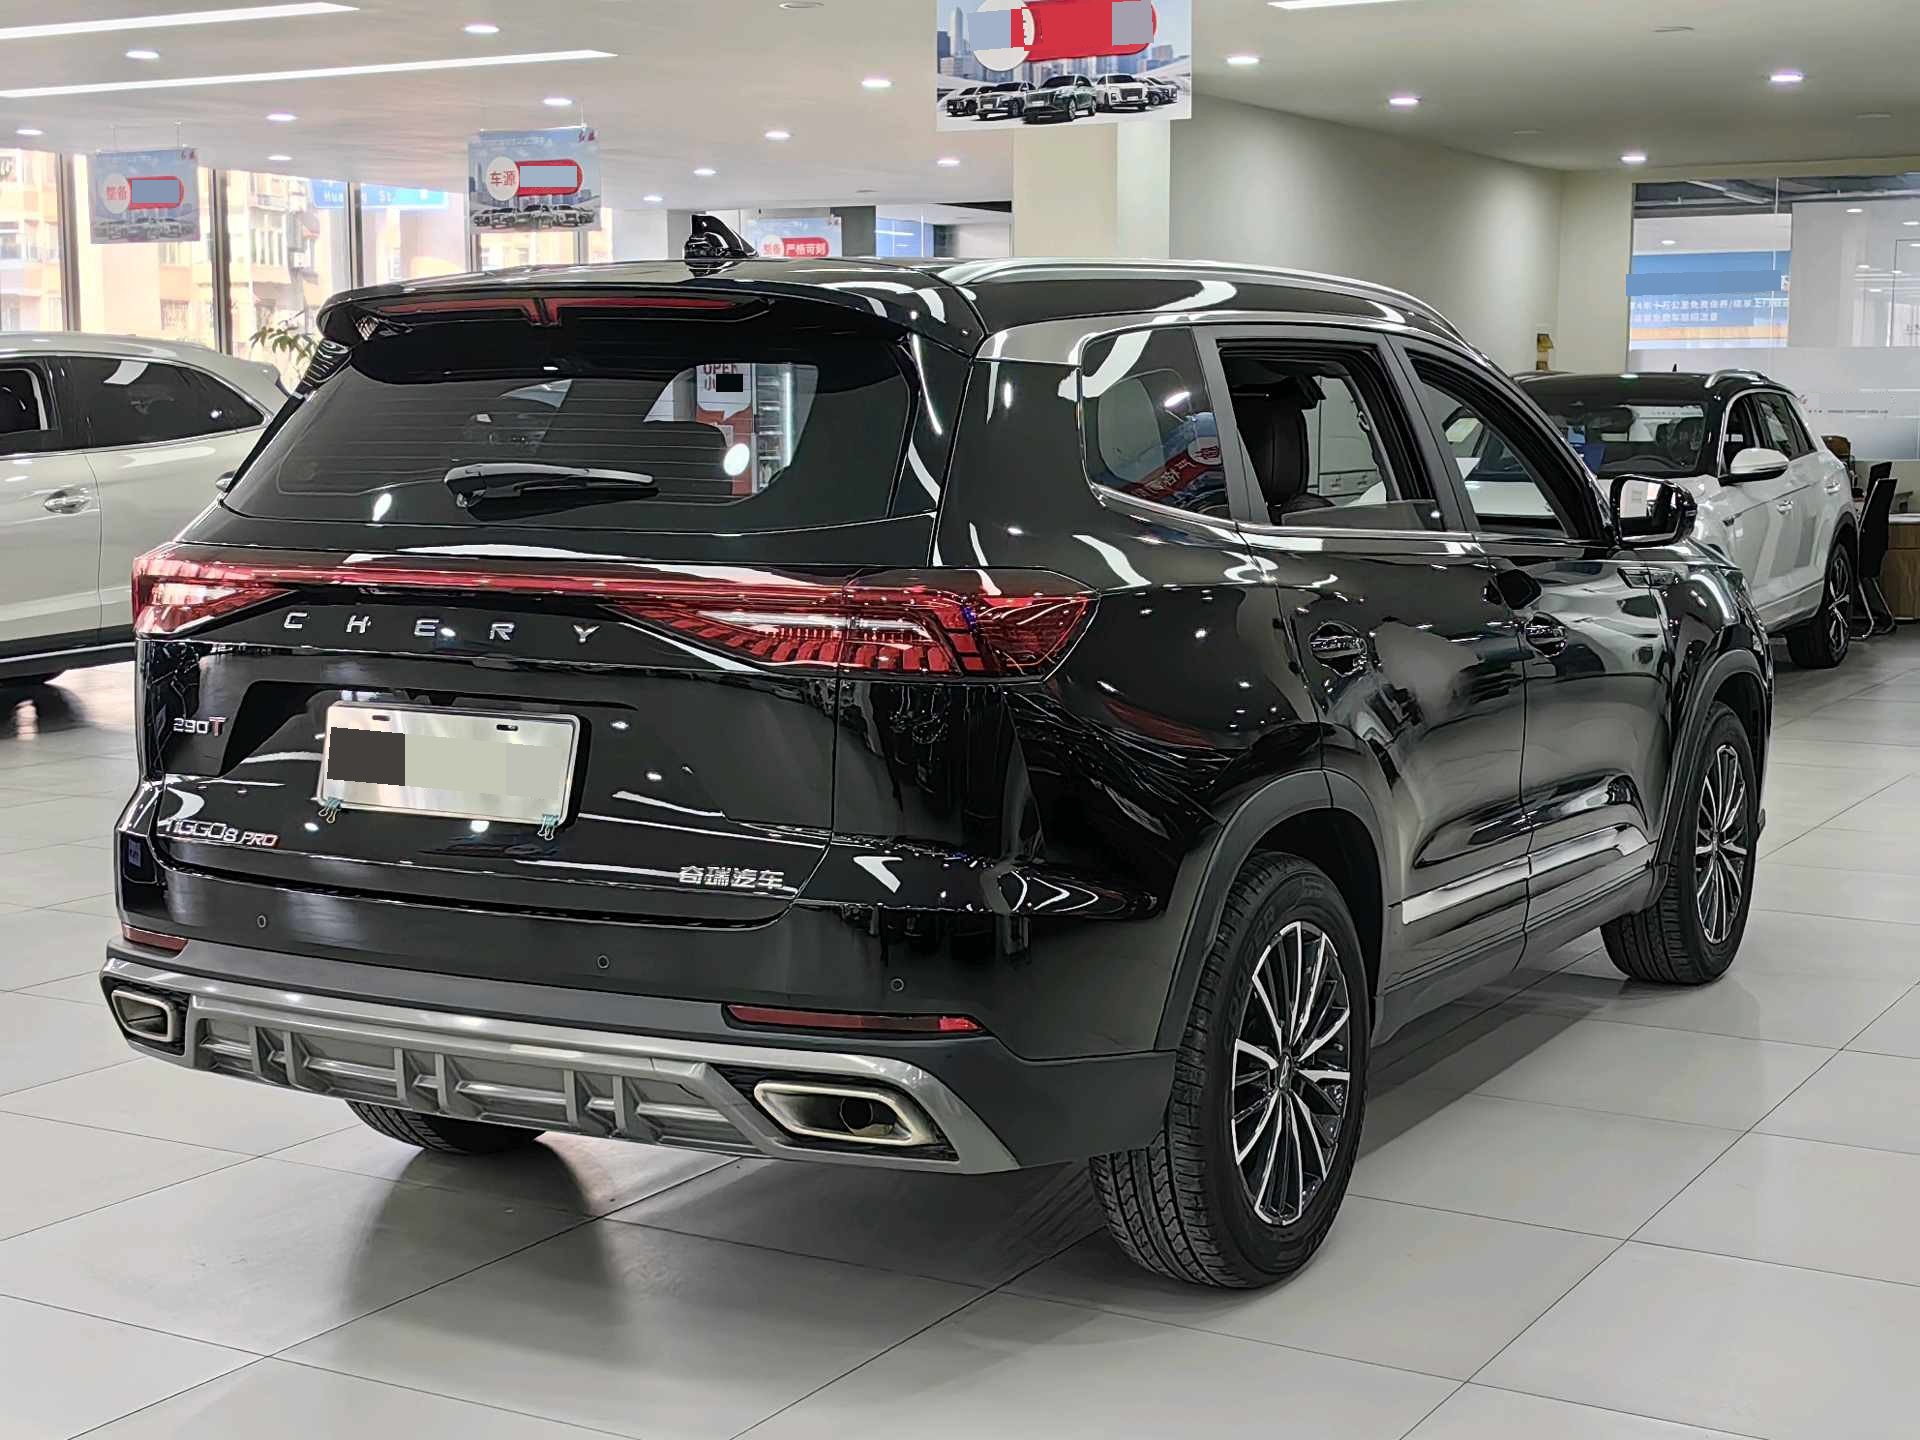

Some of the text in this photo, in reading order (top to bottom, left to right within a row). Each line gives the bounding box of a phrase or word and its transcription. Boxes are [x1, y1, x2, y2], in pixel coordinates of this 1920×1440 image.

[489, 170, 516, 186] 车源
[283, 611, 601, 644] CHERY
[173, 716, 226, 737] 290T
[238, 831, 279, 847] PRO
[679, 865, 785, 889] 奇瑞汽车
